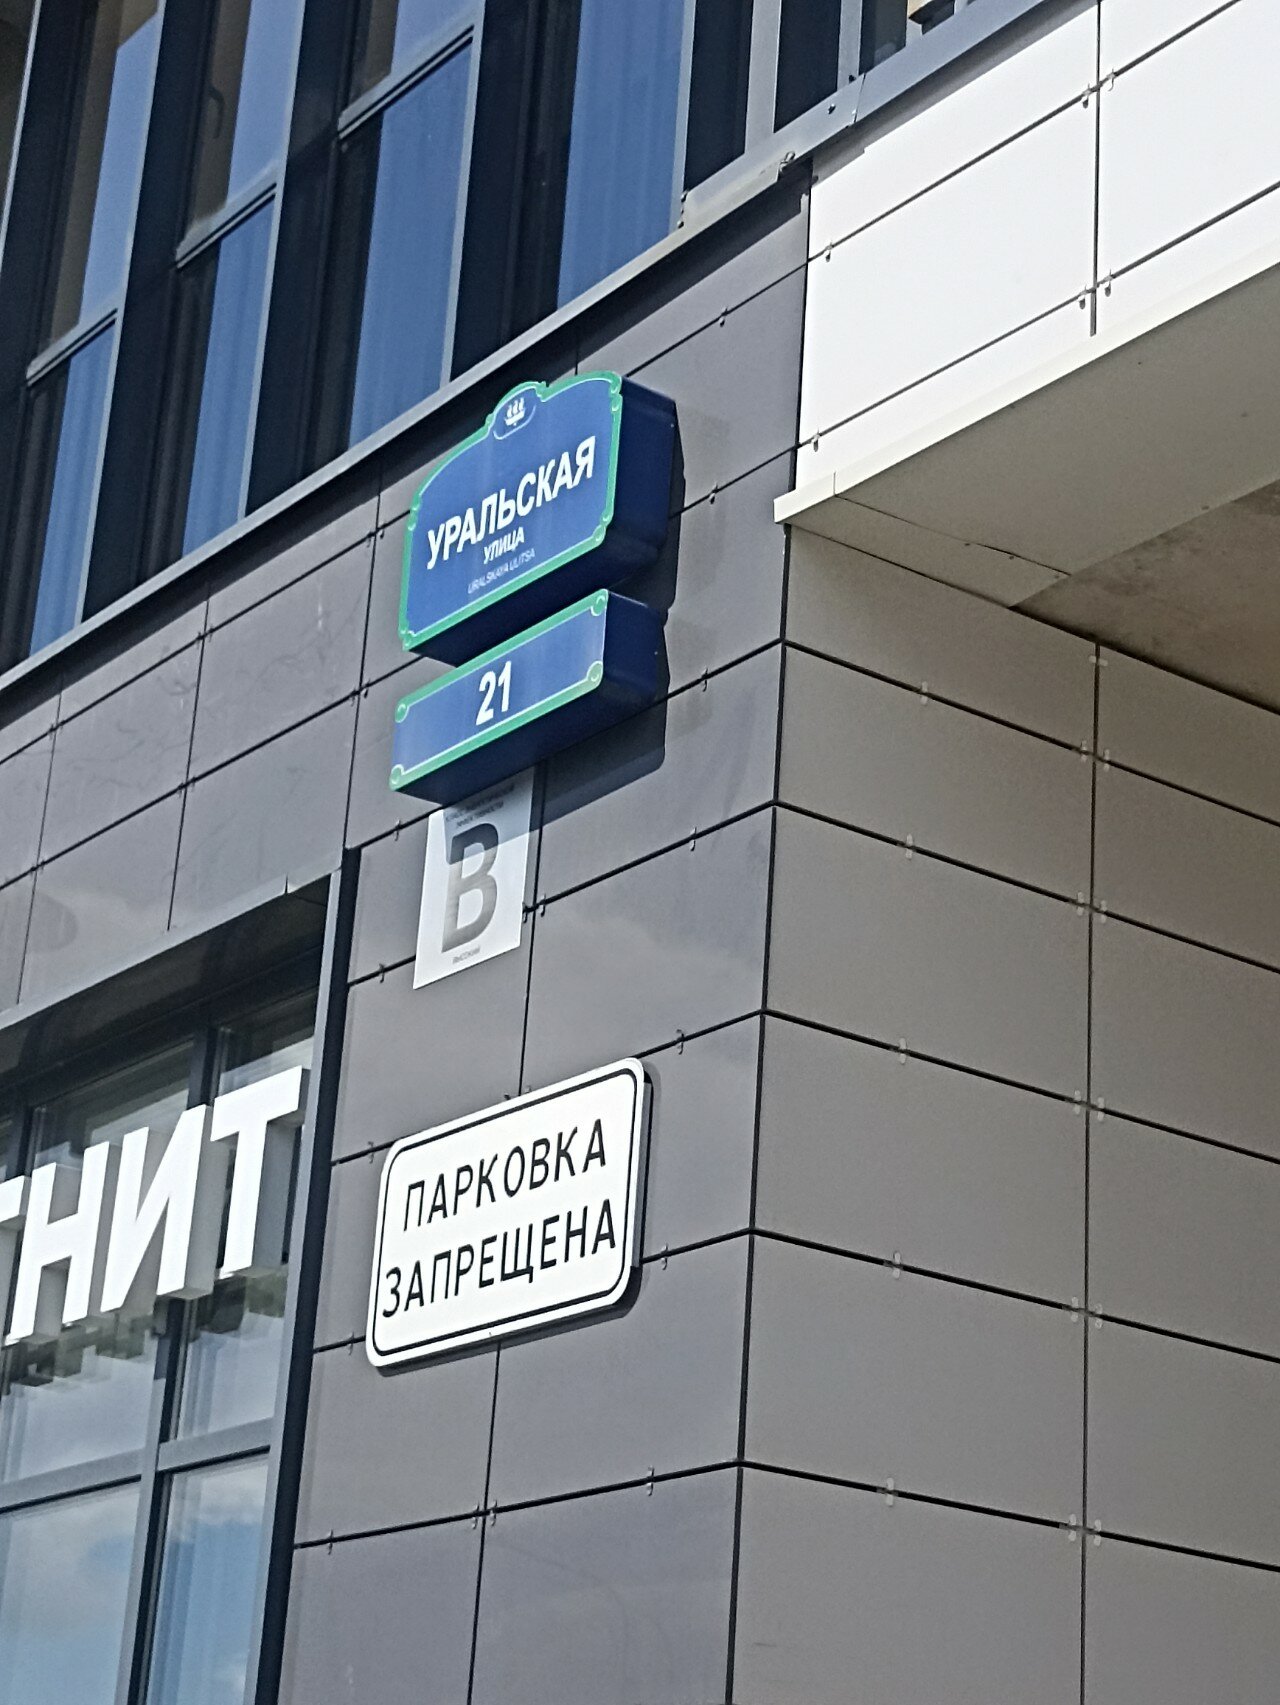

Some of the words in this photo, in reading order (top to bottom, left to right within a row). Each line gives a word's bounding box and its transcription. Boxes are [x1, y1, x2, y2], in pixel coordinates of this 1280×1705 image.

[426, 435, 596, 569] УРАЛЬСКАЯ
[483, 526, 525, 565] УЛИЦА
[476, 661, 512, 726] 21
[441, 823, 499, 953] В
[403, 1118, 606, 1232] ПАРКОВКА
[382, 1198, 616, 1318] ЗАПРЕЩЕНА
